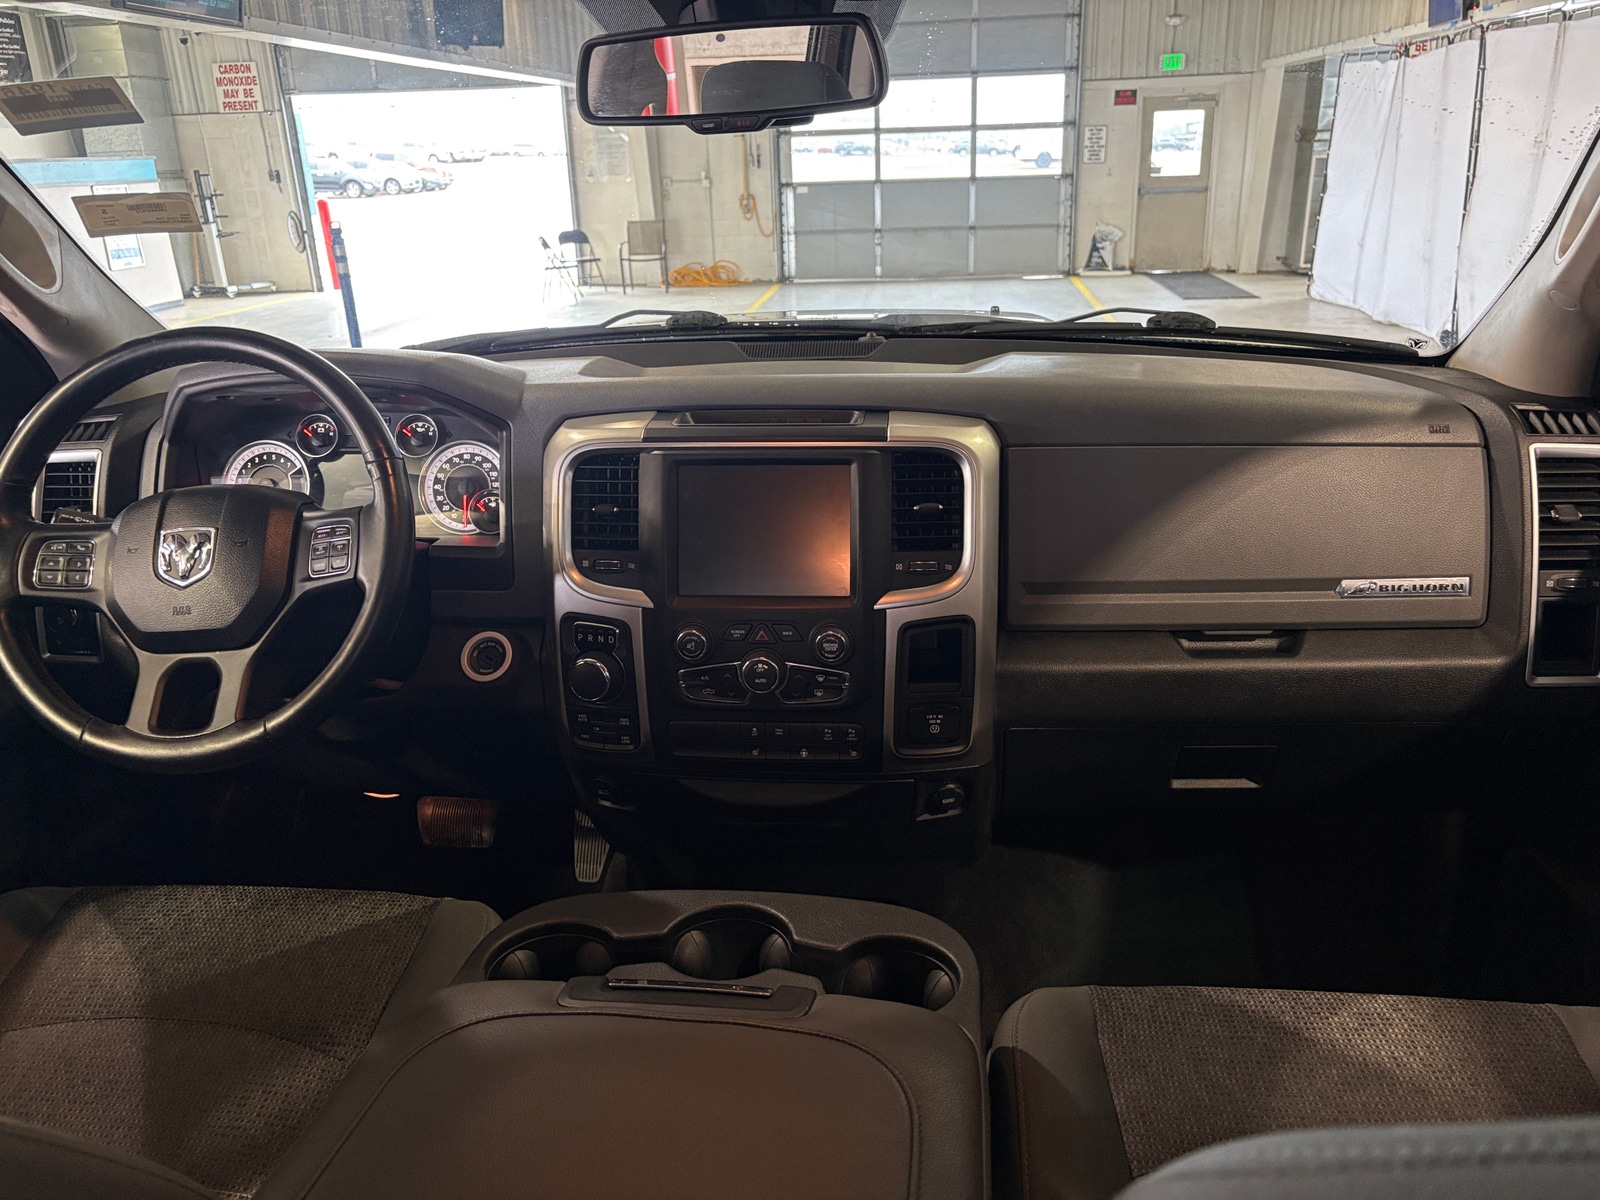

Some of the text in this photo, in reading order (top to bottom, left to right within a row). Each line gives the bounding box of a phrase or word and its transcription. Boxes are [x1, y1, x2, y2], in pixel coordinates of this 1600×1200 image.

[218, 64, 252, 74] CARBON
[216, 76, 258, 87] MONOXIDE
[223, 88, 254, 99] MAY BE
[222, 101, 258, 111] PRESENT
[1378, 583, 1464, 592] BIG HORN
[608, 636, 614, 644] D
